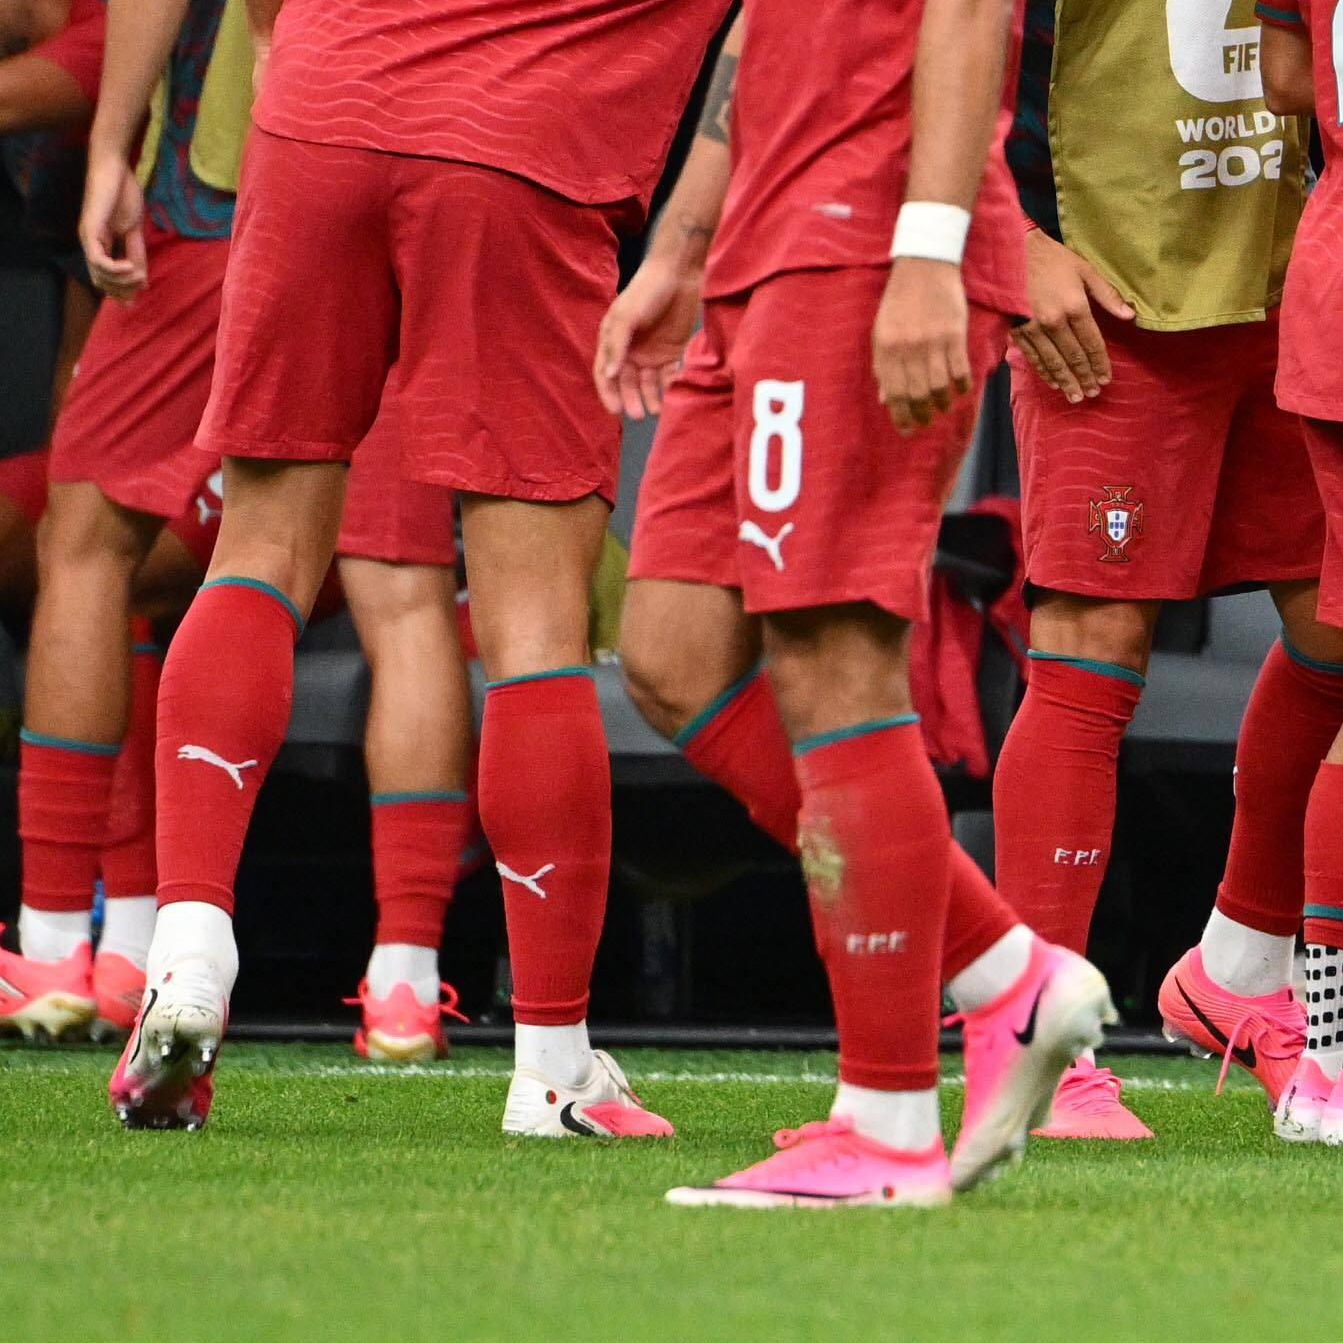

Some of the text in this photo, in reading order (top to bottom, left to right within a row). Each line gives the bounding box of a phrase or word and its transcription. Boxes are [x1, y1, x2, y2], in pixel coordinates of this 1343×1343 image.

[1222, 41, 1259, 74] FIF
[1175, 110, 1276, 144] WORLD
[1178, 139, 1284, 190] 202
[748, 378, 805, 513] 8
